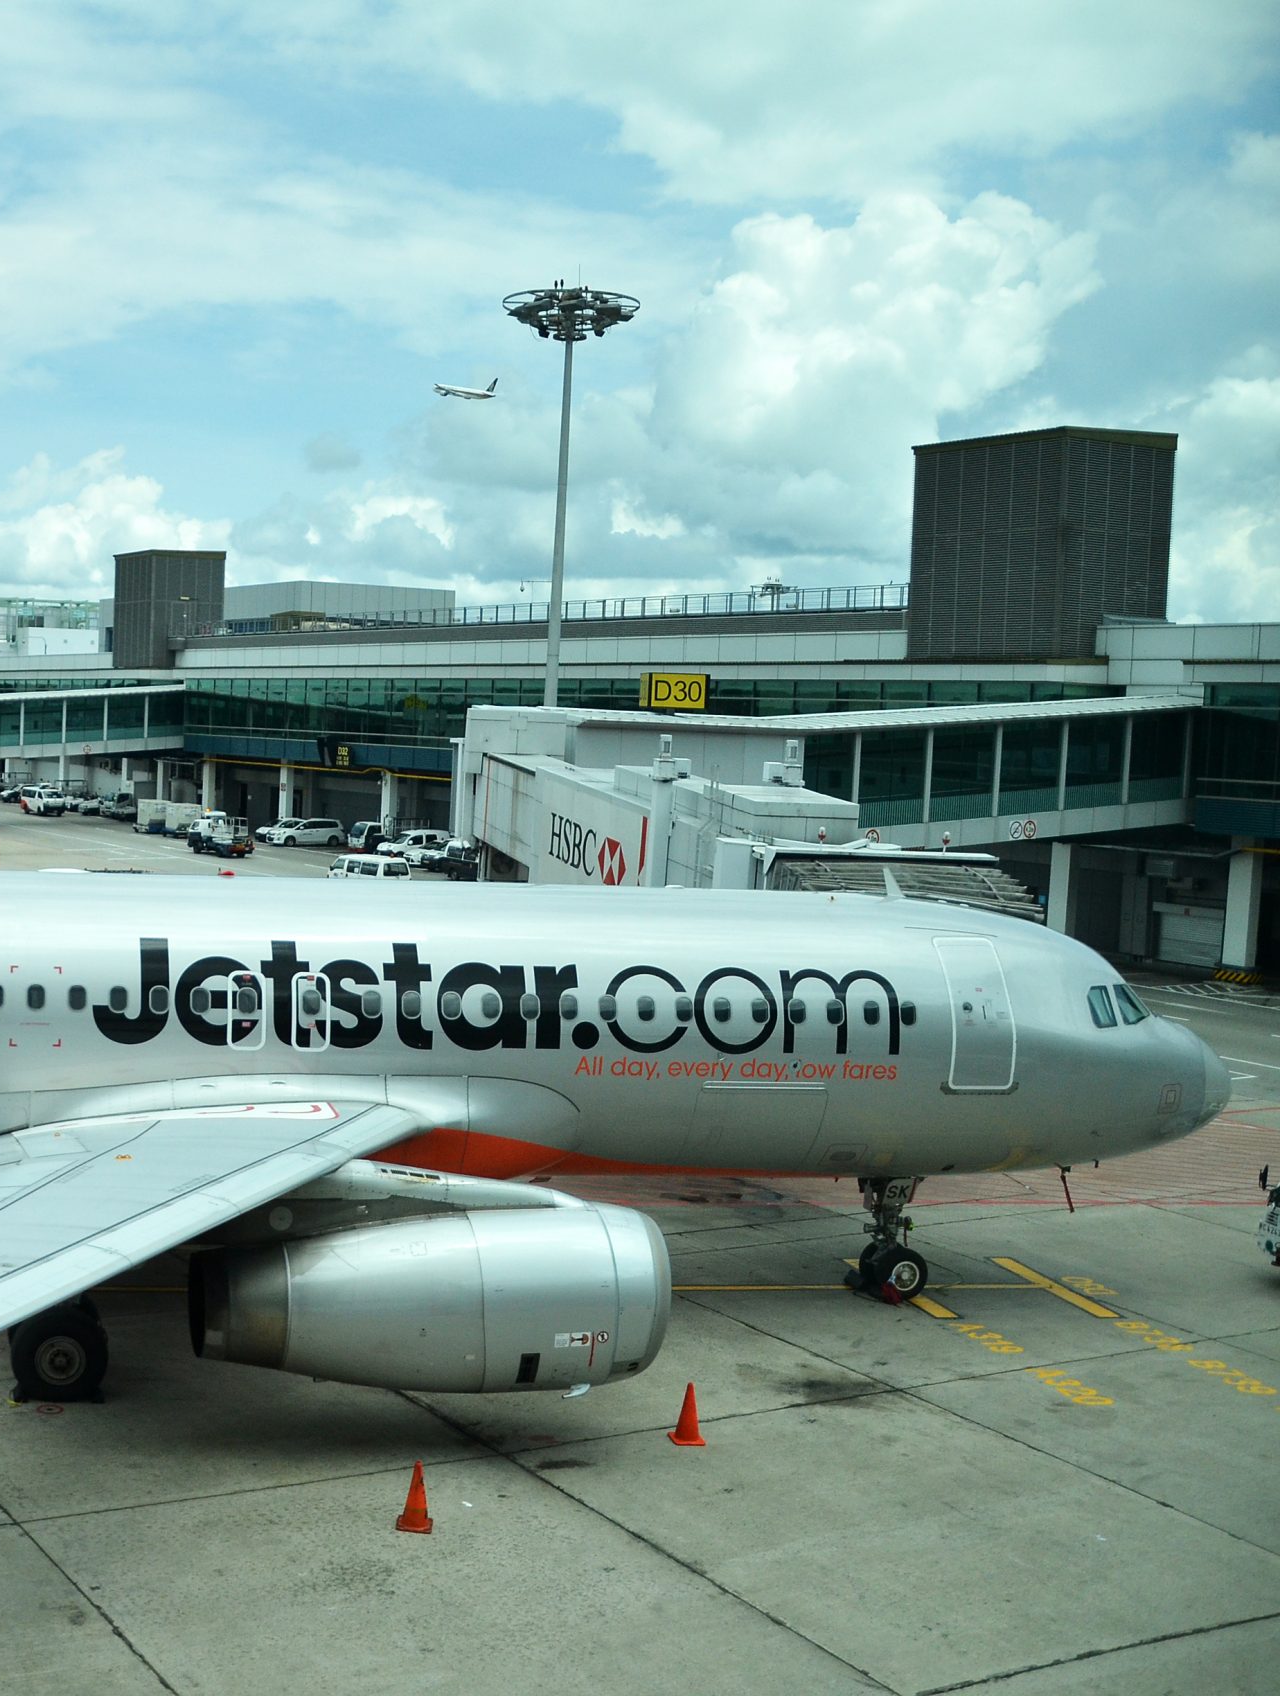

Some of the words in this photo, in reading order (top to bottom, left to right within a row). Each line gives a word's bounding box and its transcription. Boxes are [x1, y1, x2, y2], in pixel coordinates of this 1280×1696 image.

[654, 680, 702, 702] D30
[549, 812, 597, 876] HSBC
[93, 937, 901, 1056] Jetstar.com
[574, 1056, 603, 1076] All
[611, 1057, 660, 1080] day,
[668, 1061, 733, 1081] every
[740, 1058, 788, 1081] day,
[842, 1060, 897, 1080] fares
